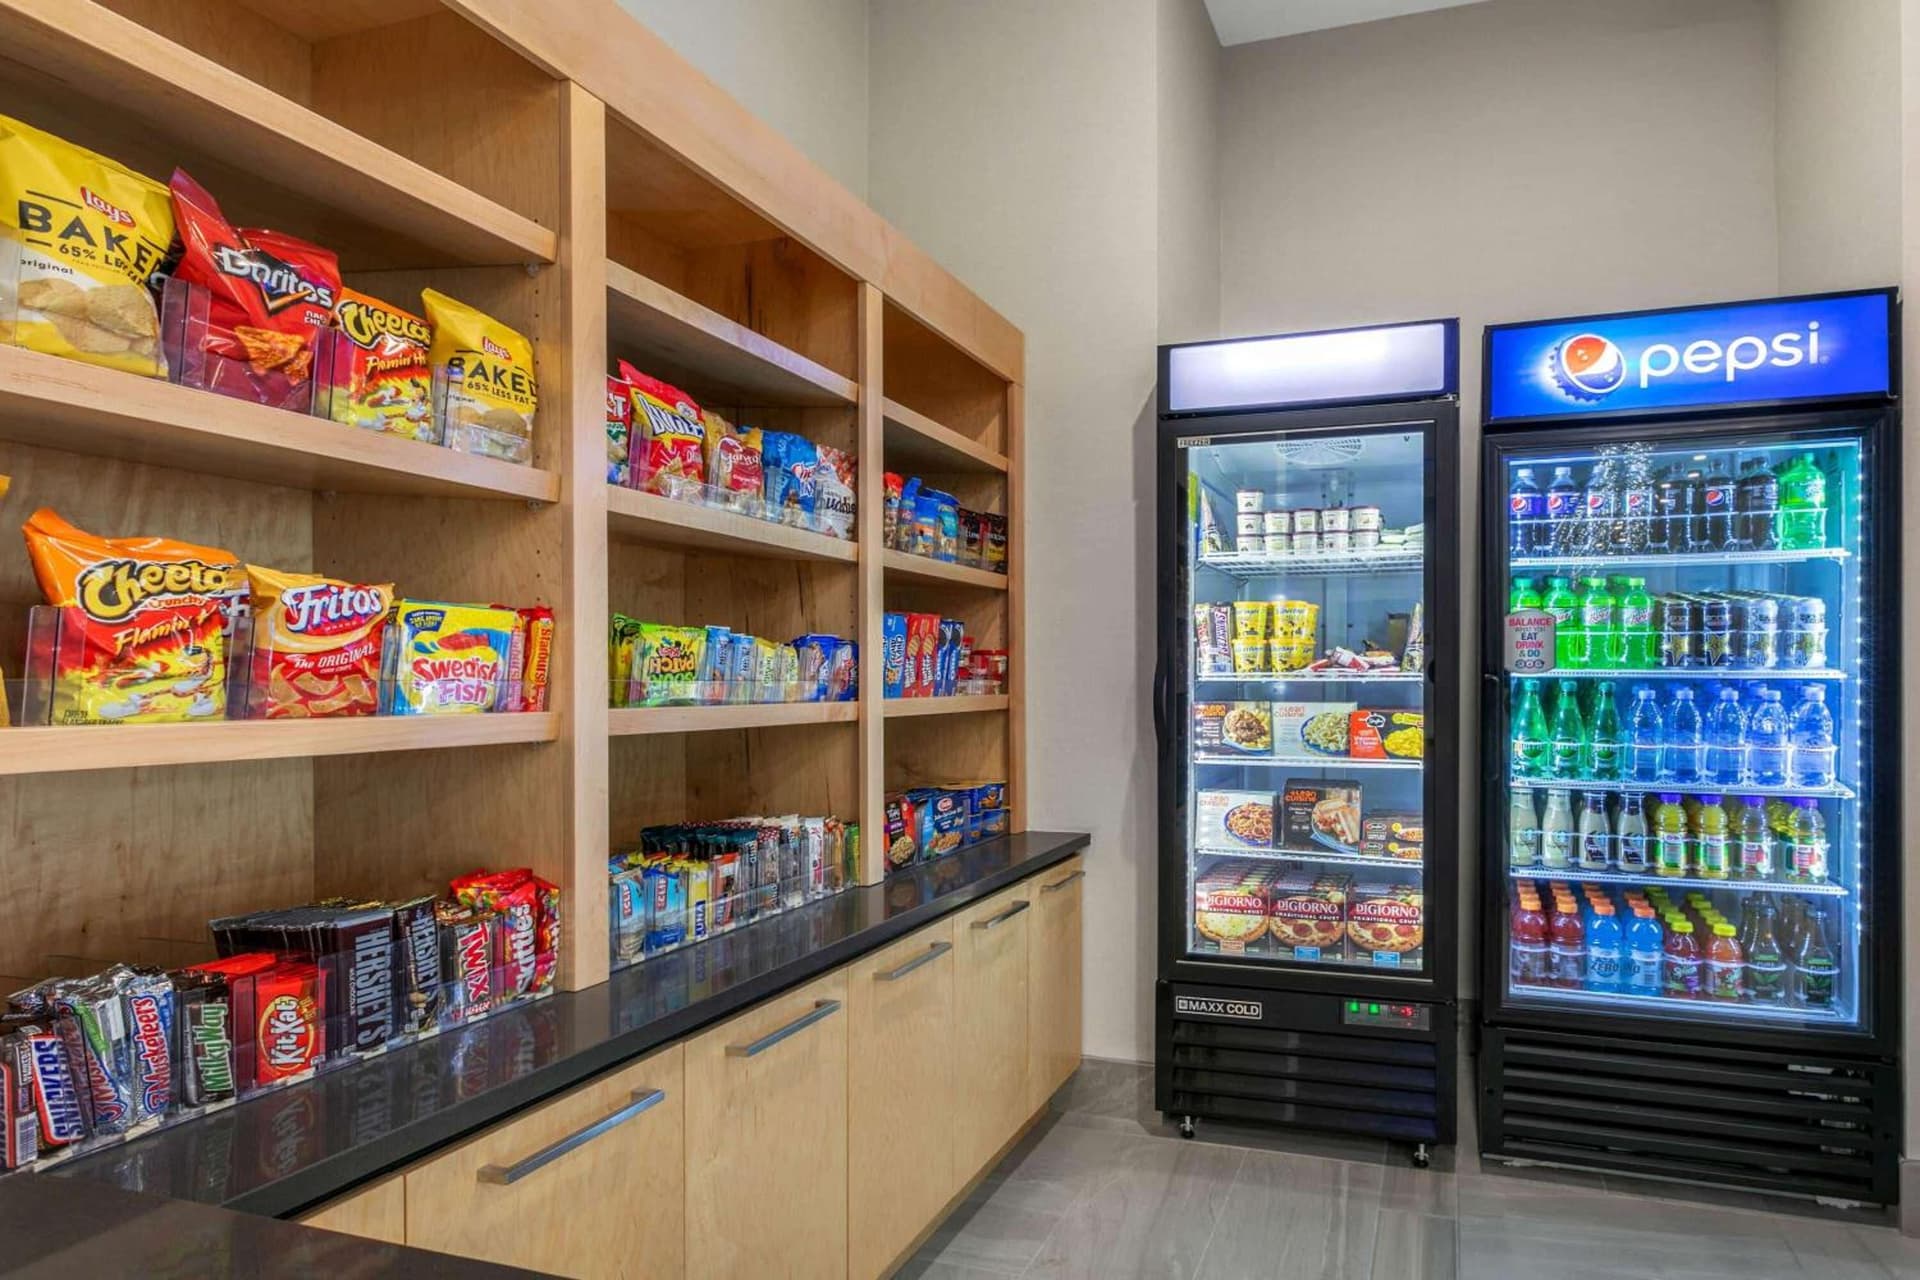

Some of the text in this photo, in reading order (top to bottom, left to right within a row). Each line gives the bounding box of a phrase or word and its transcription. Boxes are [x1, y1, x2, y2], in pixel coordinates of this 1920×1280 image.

[58, 243, 97, 261] 65%
[216, 246, 334, 310] Doritos
[1639, 320, 1821, 390] pepsi
[82, 561, 228, 622] Cheeto
[281, 583, 383, 633] Fritos
[1508, 617, 1553, 627] BALANCE
[1515, 640, 1544, 649] DRINK
[1521, 632, 1537, 641] EAT
[317, 643, 376, 669] ORIGINAL
[648, 654, 695, 674] PATCH
[411, 656, 498, 683] Swedish
[438, 679, 489, 706] Fish
[1277, 899, 1338, 914] DIGIORNO
[1355, 902, 1419, 918] DIGIORNO
[457, 922, 491, 1003] TWIX
[1188, 1000, 1259, 1016] MAXX COLD
[132, 996, 171, 1094] Musketeers
